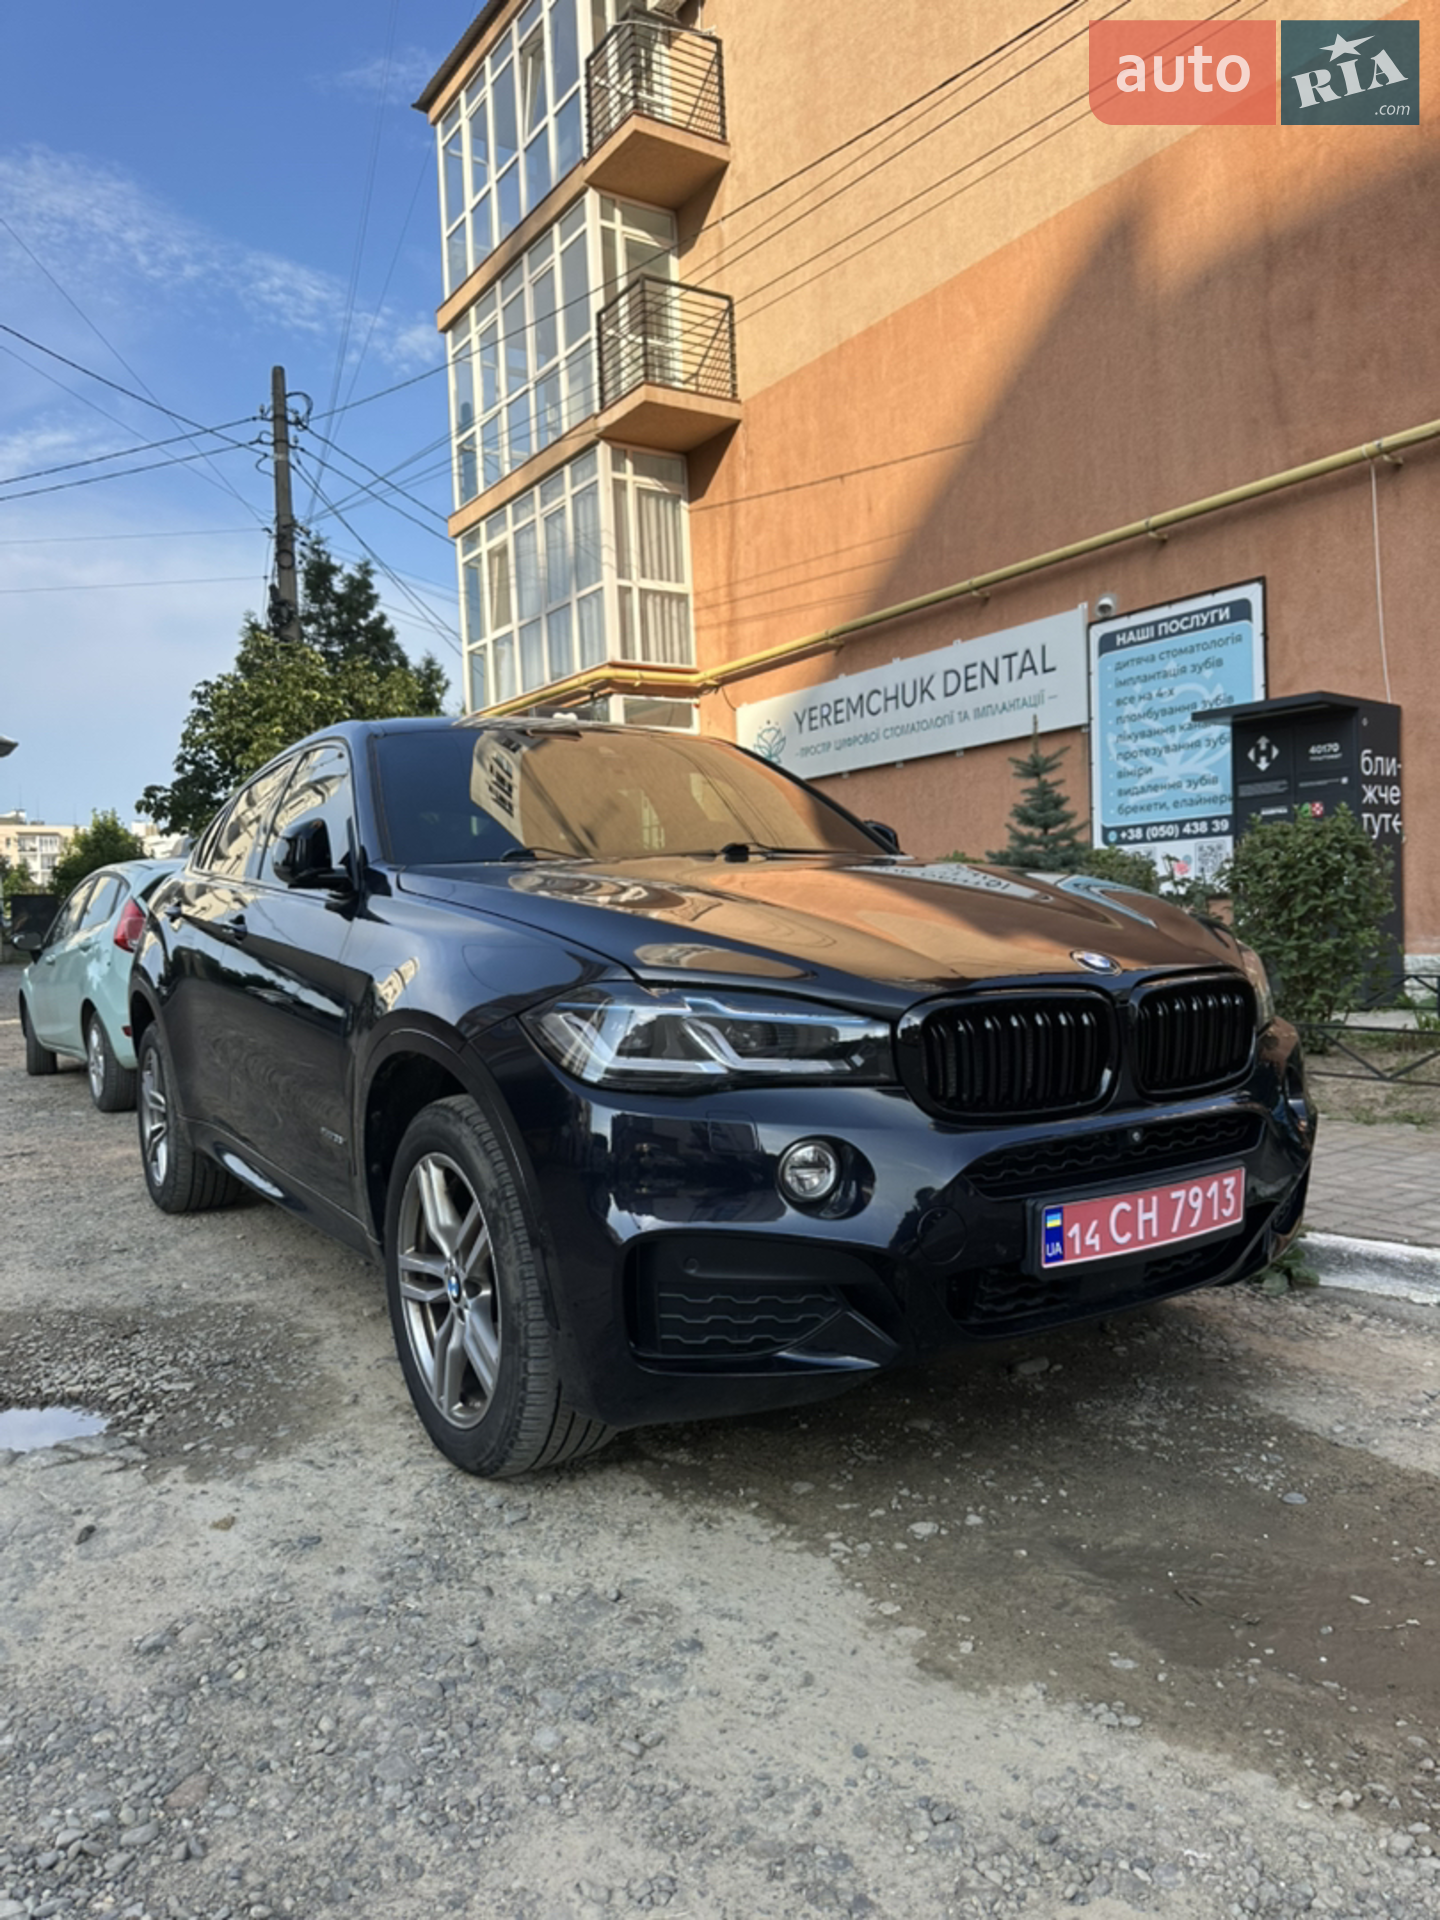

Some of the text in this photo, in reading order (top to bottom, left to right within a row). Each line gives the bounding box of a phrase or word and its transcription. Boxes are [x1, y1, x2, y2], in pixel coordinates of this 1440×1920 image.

[1116, 606, 1231, 646] НАШІ ПОСЛУГИ
[1114, 632, 1243, 672] дитяча стоматологія
[1114, 655, 1224, 688] імплантація зубів
[793, 644, 1057, 735] YEREMCHUK DENTAL
[1115, 694, 1136, 707] все
[1138, 691, 1153, 702] на
[957, 710, 970, 724] ТА
[973, 689, 1045, 720] ІМПЛАНТАЦІЇ
[1116, 692, 1235, 725] пломбування зубів
[1116, 724, 1176, 743] лікування
[1116, 738, 1202, 762] протезування
[1116, 765, 1153, 780] вініри
[1117, 780, 1183, 797] видалення
[1185, 773, 1219, 790] зубів
[1361, 783, 1401, 805] жче
[1120, 818, 1230, 841] +38 (050) 438 39
[1067, 1176, 1236, 1256] 14 CH 7913
[1046, 1241, 1063, 1258] UA
